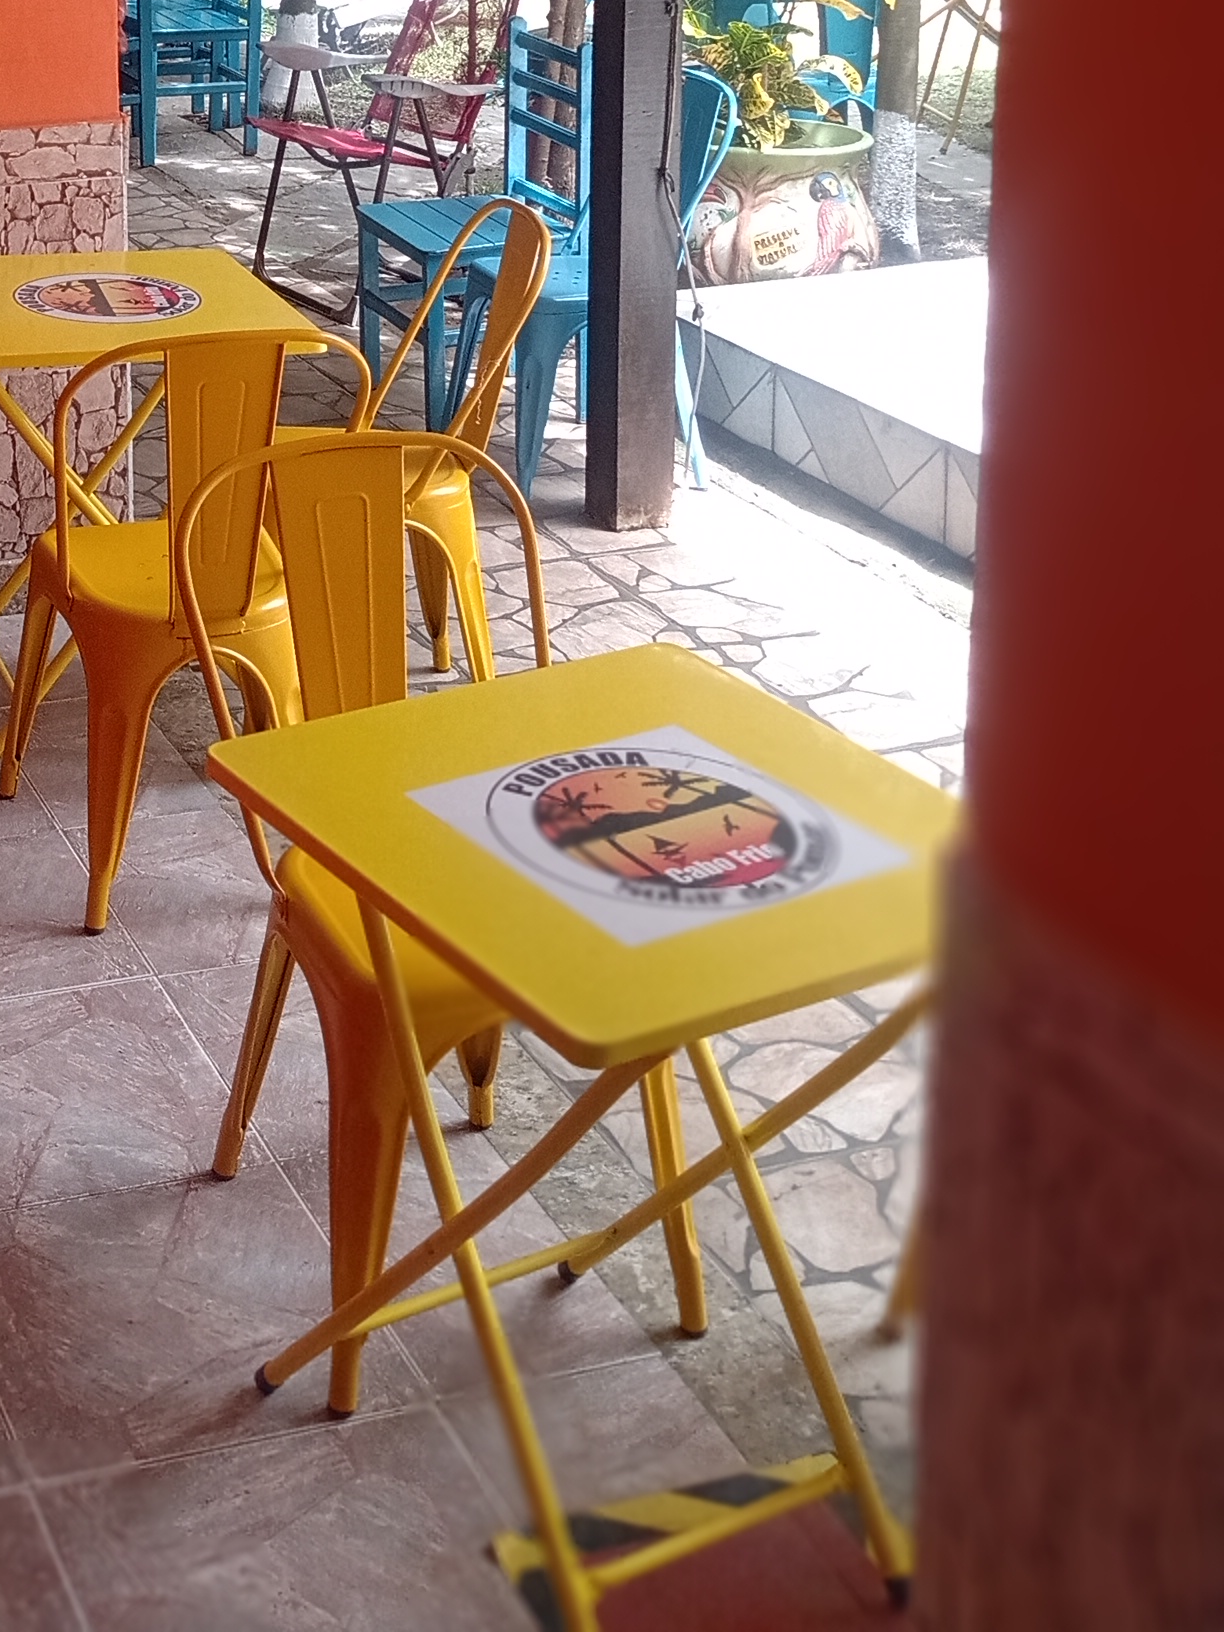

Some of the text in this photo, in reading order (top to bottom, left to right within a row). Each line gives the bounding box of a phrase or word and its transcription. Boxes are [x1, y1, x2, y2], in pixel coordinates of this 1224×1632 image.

[754, 227, 800, 250] PRESERVE
[503, 751, 649, 797] POUSADA
[664, 855, 731, 884] Cabo
[725, 842, 786, 867] Frio
